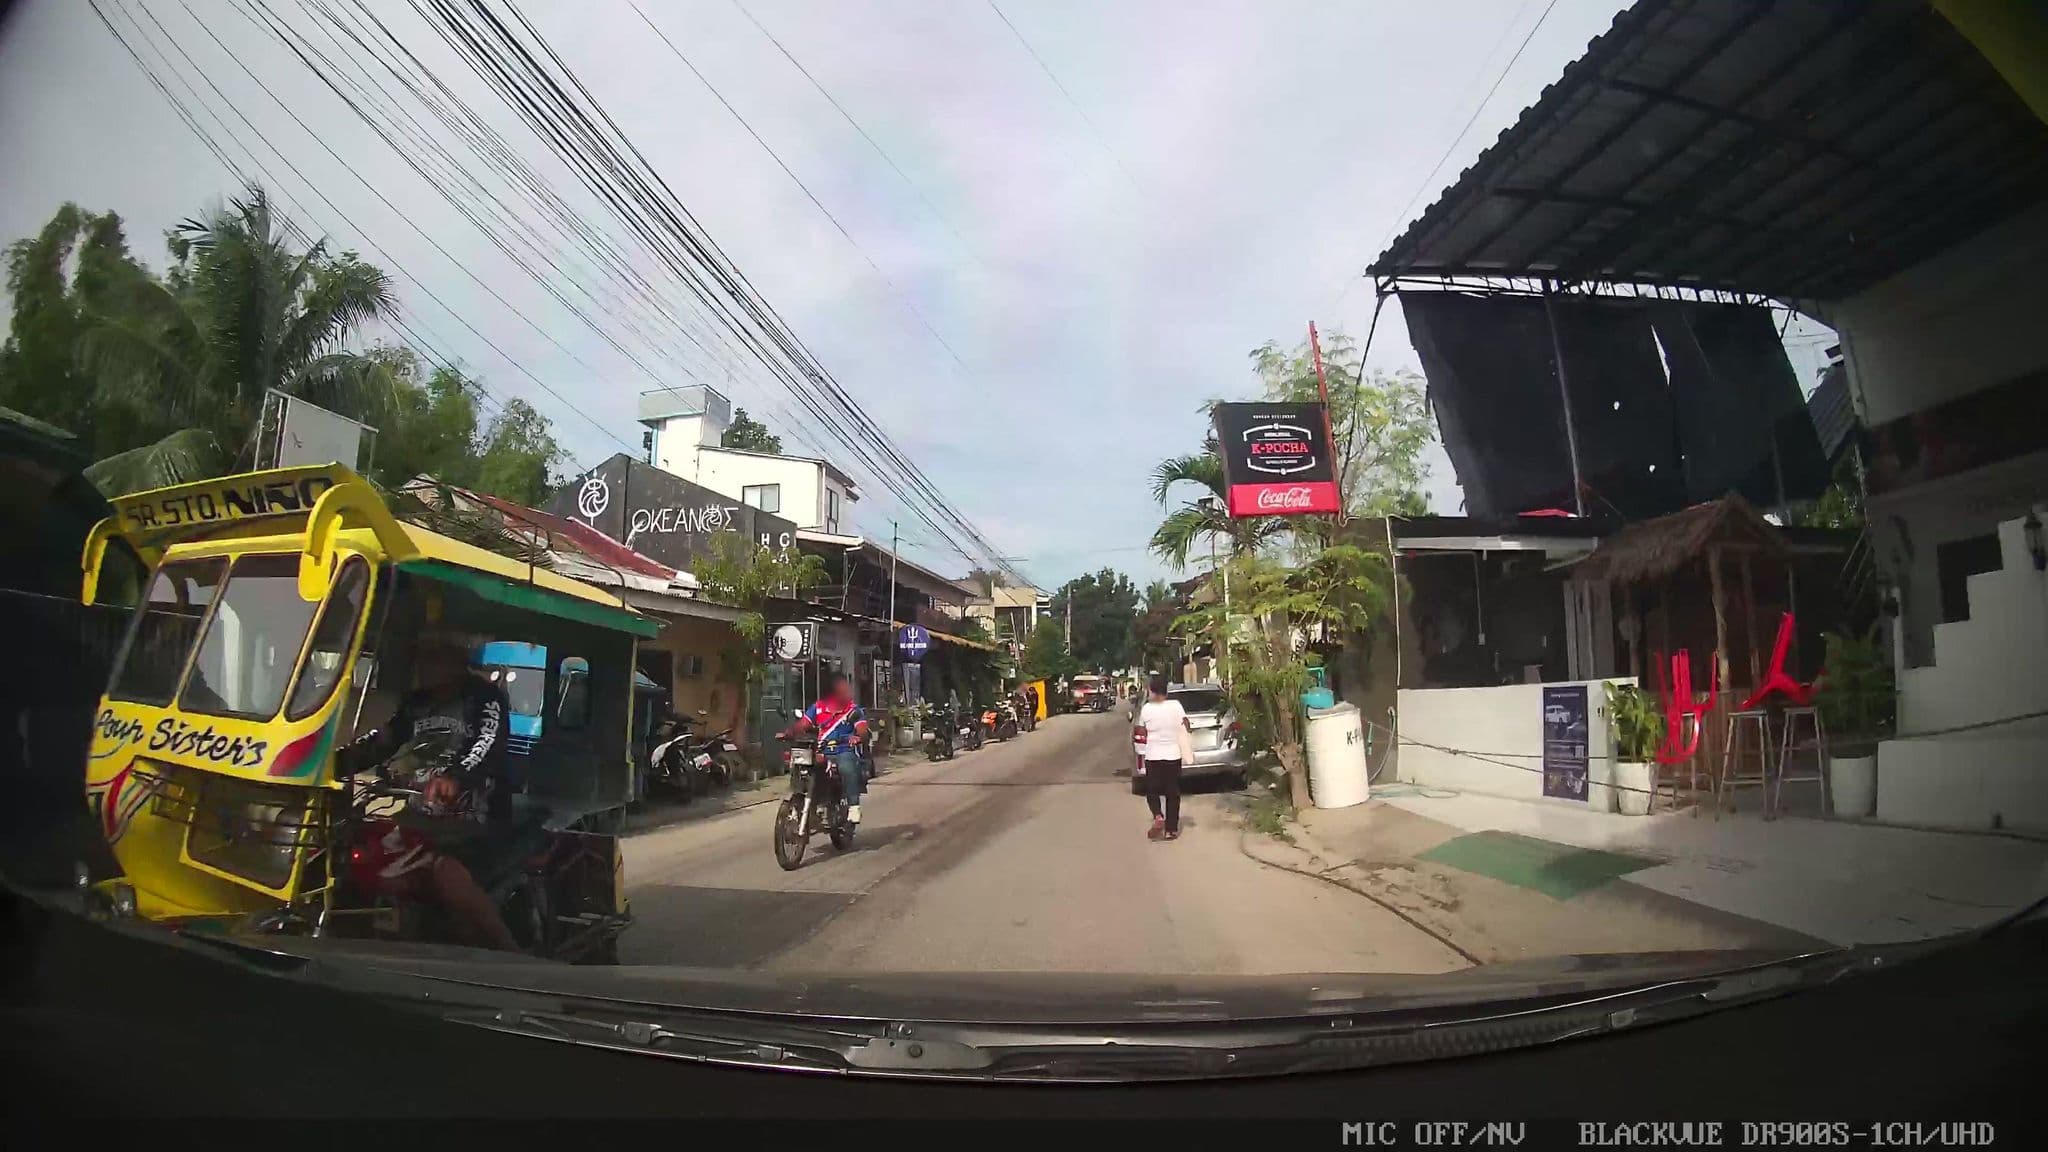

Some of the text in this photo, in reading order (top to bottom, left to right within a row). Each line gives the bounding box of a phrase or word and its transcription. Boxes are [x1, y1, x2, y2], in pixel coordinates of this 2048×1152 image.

[1251, 442, 1309, 455] K-POCHA
[162, 493, 222, 525] STO.
[149, 717, 267, 766] Sister's
